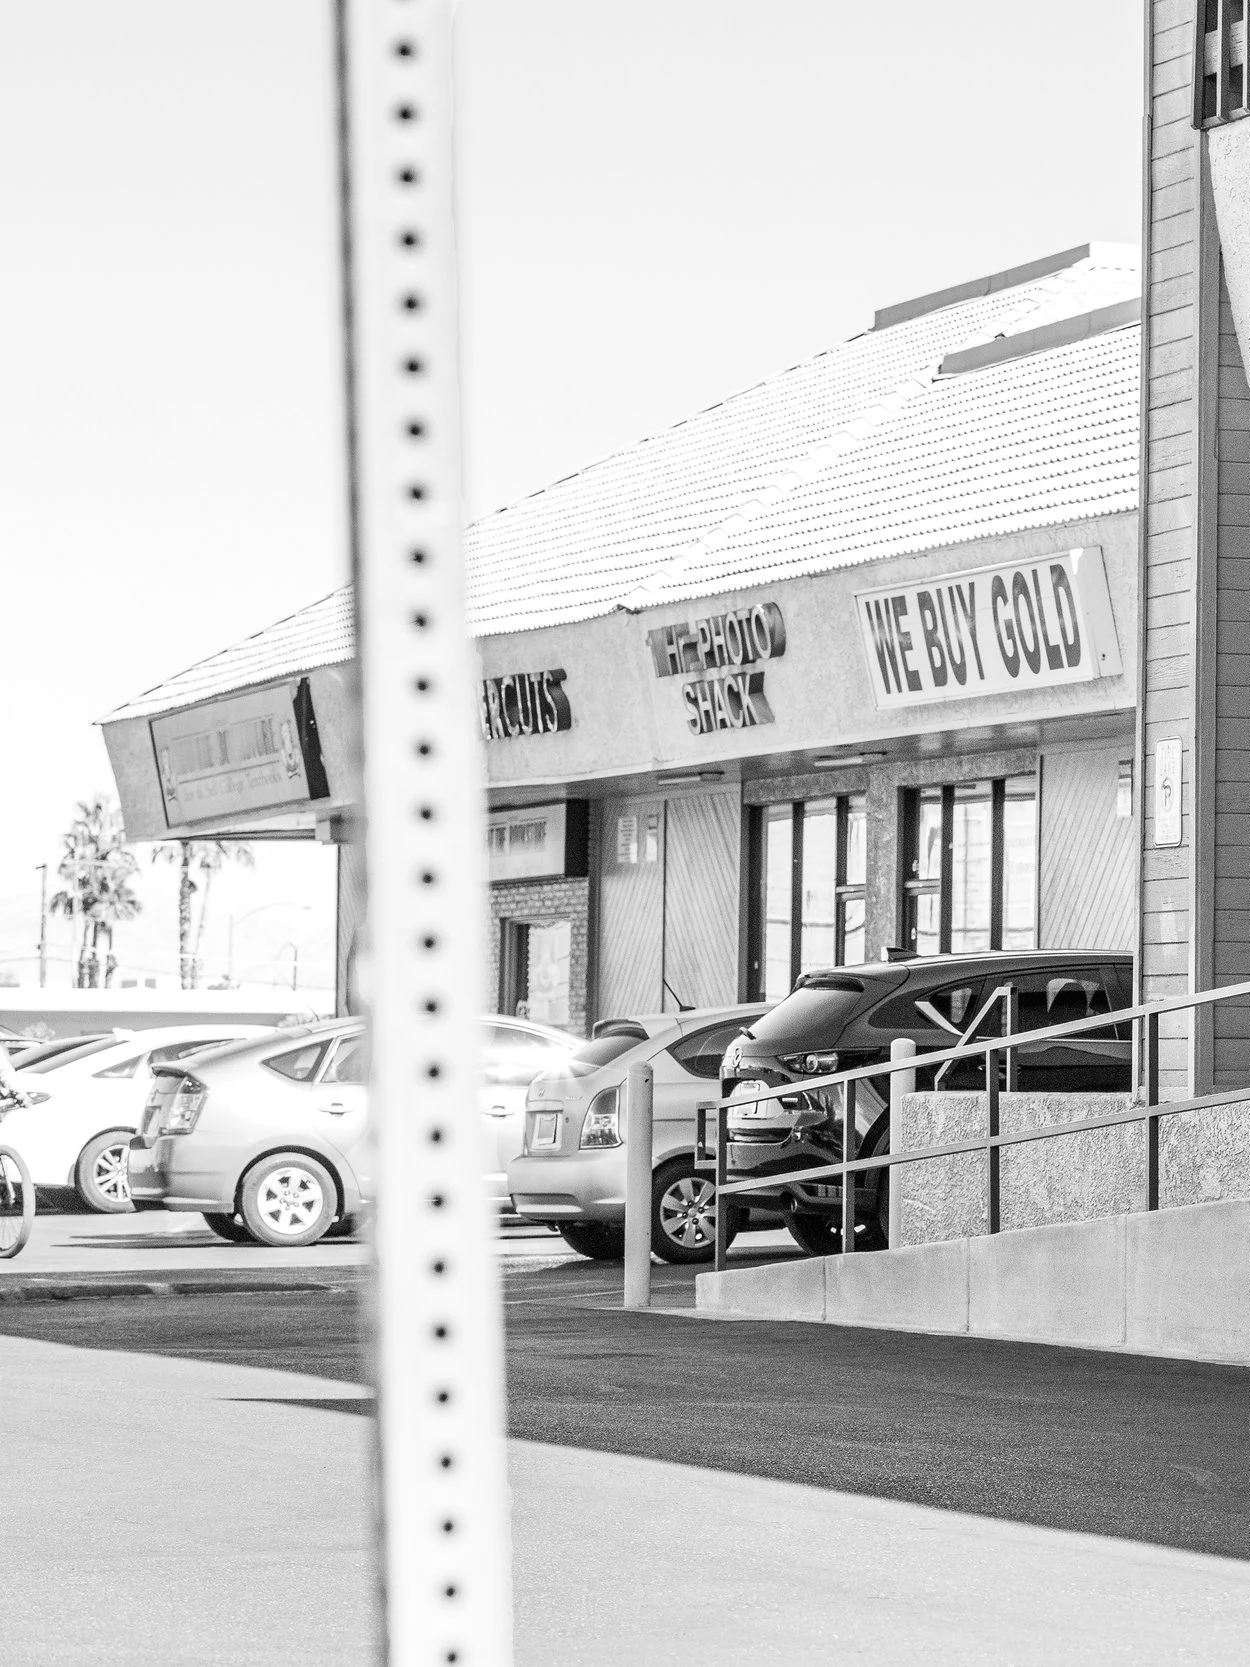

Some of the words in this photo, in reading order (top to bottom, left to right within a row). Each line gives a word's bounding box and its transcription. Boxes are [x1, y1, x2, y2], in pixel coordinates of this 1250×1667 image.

[865, 595, 923, 694] WE
[917, 581, 985, 687] BUY
[991, 563, 1082, 678] GOLD
[682, 675, 768, 736] SHACK
